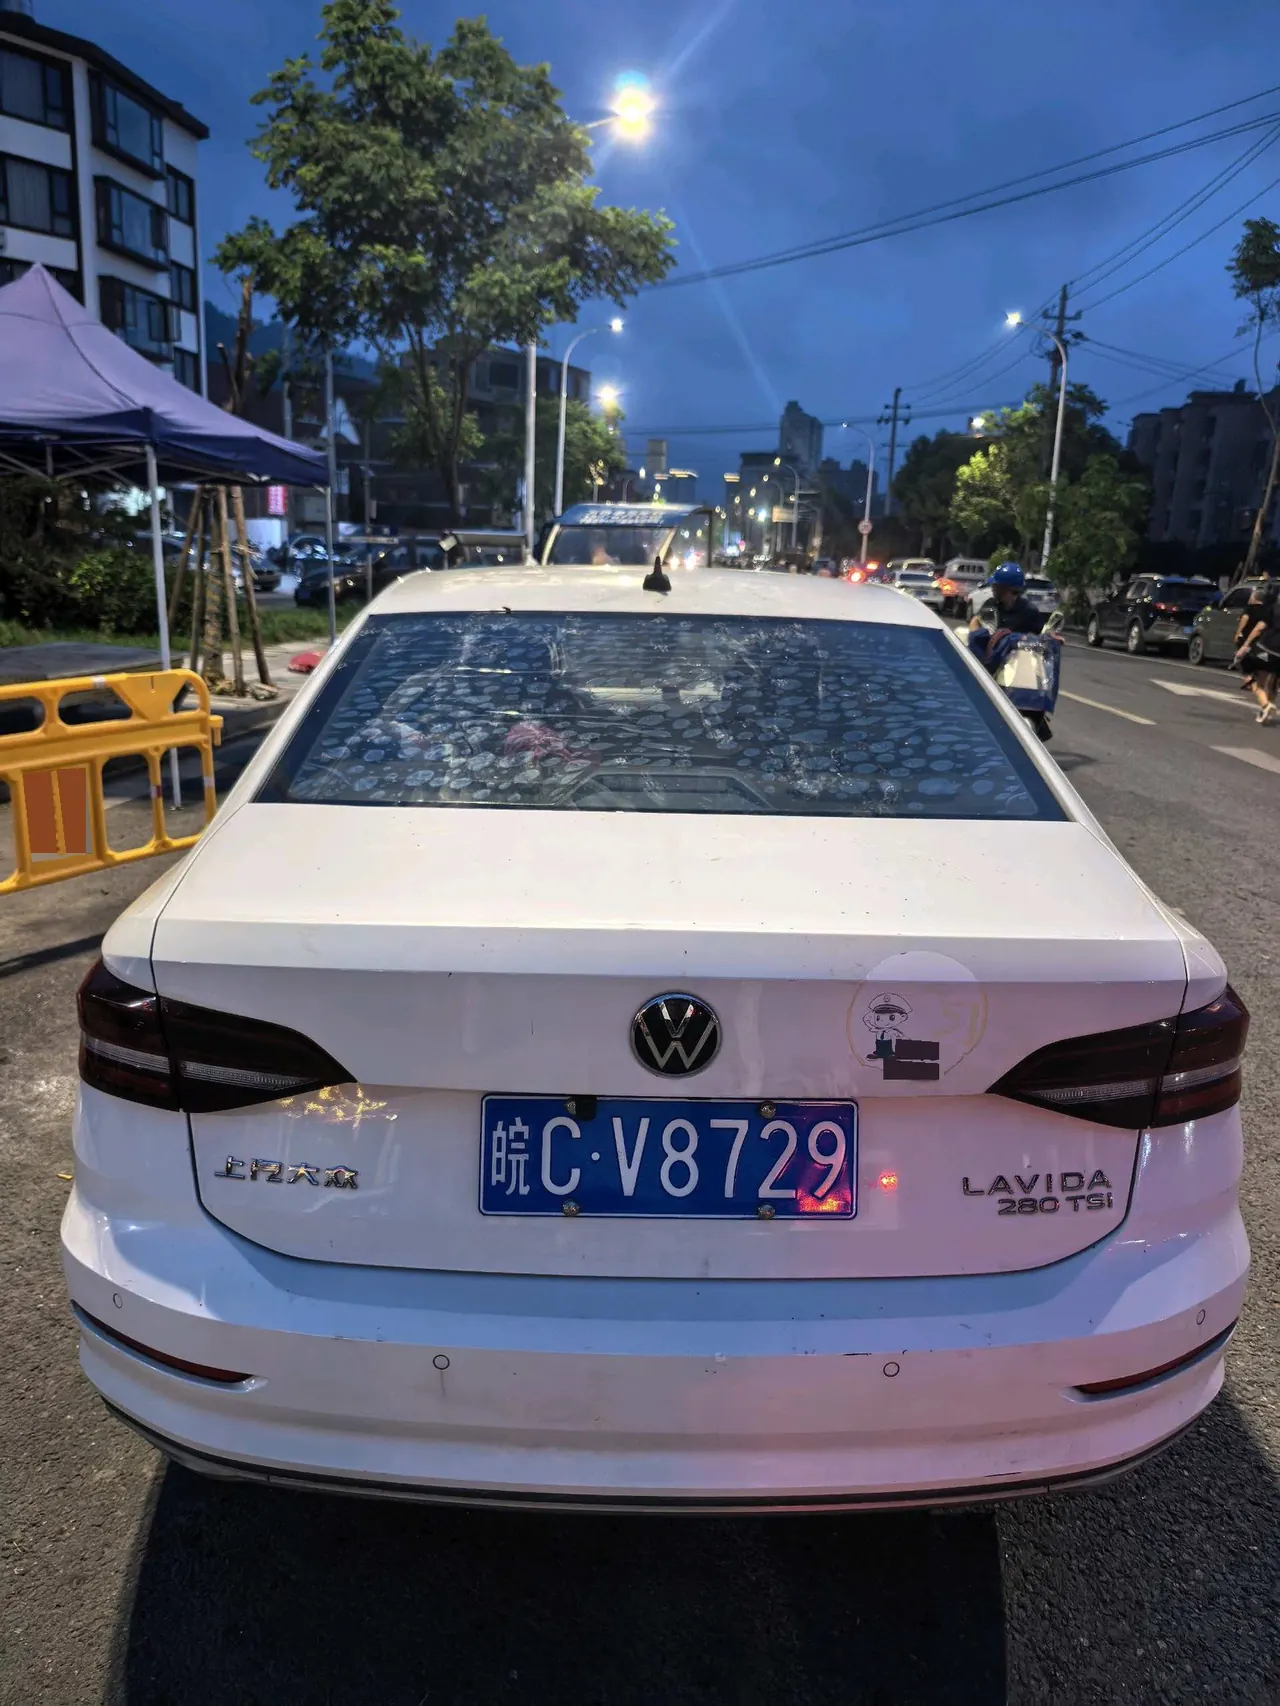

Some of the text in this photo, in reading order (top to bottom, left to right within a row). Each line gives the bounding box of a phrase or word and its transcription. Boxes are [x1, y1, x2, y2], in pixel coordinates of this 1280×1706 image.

[635, 997, 719, 1071] VW
[962, 1169, 1113, 1197] LAVIDA
[998, 1196, 1061, 1216] 280
